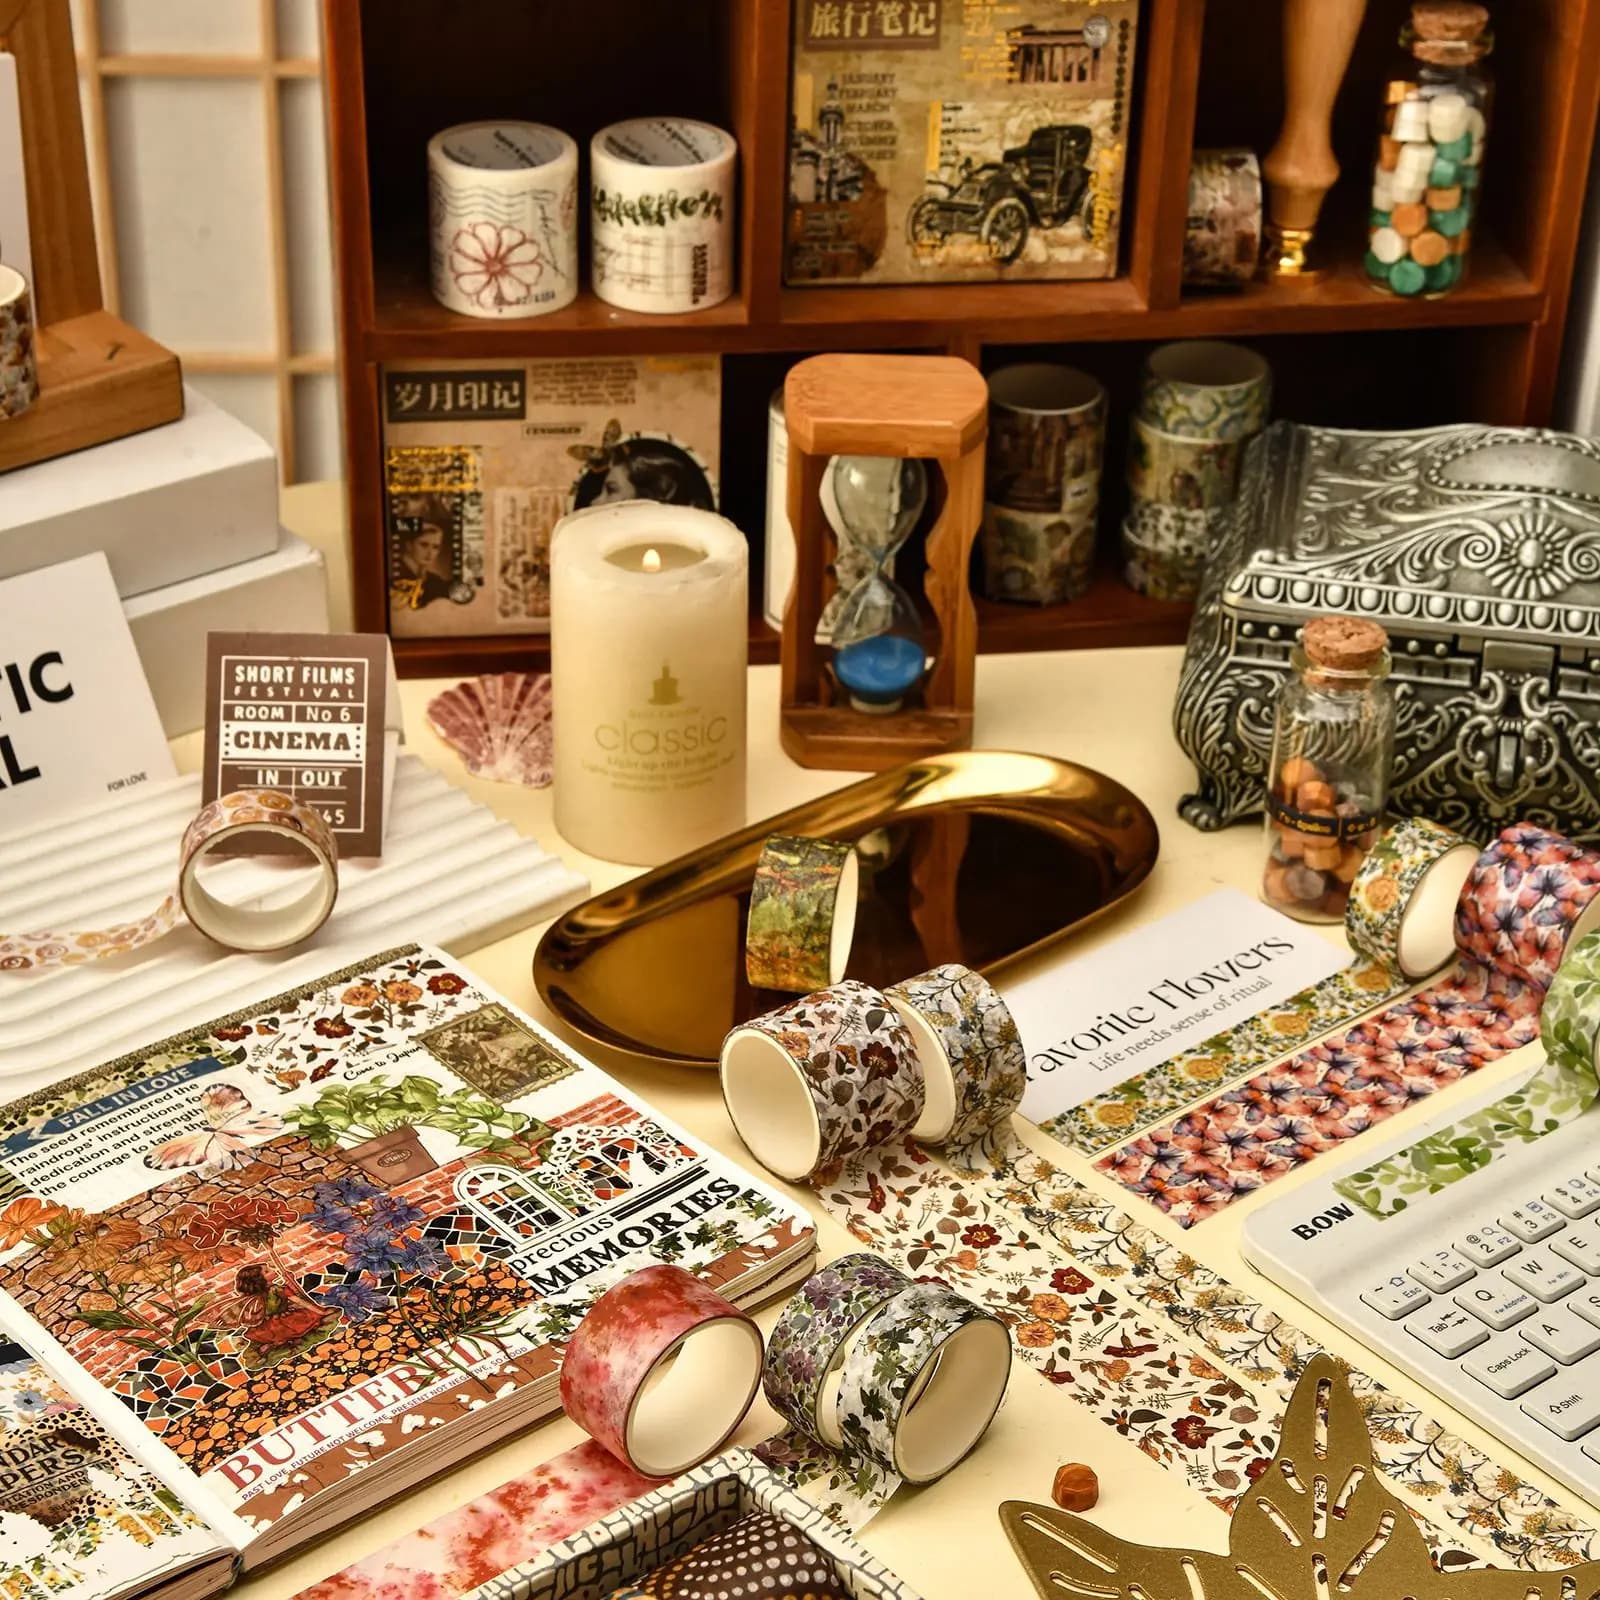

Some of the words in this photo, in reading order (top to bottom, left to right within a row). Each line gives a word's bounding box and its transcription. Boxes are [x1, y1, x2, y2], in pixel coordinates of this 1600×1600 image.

[810, 1, 937, 39] 旅行笔记
[394, 380, 521, 411] 岁月印记
[0, 651, 75, 715] IC
[235, 665, 296, 683] SHORT
[302, 666, 355, 685] FILMS
[234, 686, 355, 699] FESTIVAL
[234, 706, 285, 720] ROOM
[306, 706, 333, 722] No
[340, 707, 351, 722] 6
[233, 730, 351, 751] CINEMA
[594, 716, 728, 756] classic
[107, 778, 126, 792] FOR
[126, 771, 148, 787] LOVE
[257, 770, 279, 785] IN
[301, 771, 342, 786] OUT
[316, 808, 345, 824] 45
[1026, 1005, 1156, 1082] avorite
[1148, 936, 1295, 1010] Flowers
[1088, 1050, 1125, 1073] Life
[1126, 1028, 1172, 1057] needs
[1172, 1007, 1213, 1033] sense
[1213, 994, 1232, 1012] of
[1231, 975, 1273, 1003] ritual
[59, 1103, 113, 1128] FALL
[112, 1089, 139, 1107] IN
[138, 1067, 194, 1095] LOVE
[6, 1151, 38, 1167] The
[41, 1132, 78, 1153] seed
[80, 1092, 174, 1136] remembered
[173, 1083, 200, 1096] the
[19, 1138, 93, 1177] raindrops'
[96, 1102, 185, 1142] instructions
[185, 1094, 204, 1104] fo
[30, 1147, 110, 1187] dedication
[113, 1133, 141, 1151] and
[143, 1107, 205, 1136] strength
[39, 1181, 67, 1196] the
[69, 1152, 131, 1183] courage
[134, 1143, 149, 1155] to
[152, 1130, 184, 1147] take
[184, 1119, 209, 1132] the
[1571, 1196, 1582, 1204] 4
[1512, 1210, 1524, 1219] #
[1524, 1219, 1538, 1229] 3
[508, 1216, 615, 1275] precious
[527, 1176, 741, 1296] MEMORIES
[1466, 1235, 1481, 1244] @
[1480, 1243, 1495, 1253] 2
[1497, 1236, 1512, 1246] F2
[1569, 1237, 1588, 1249] E
[1452, 1262, 1466, 1271] F1
[1521, 1260, 1543, 1275] W
[1402, 1287, 1422, 1299] Esc
[1475, 1289, 1496, 1302] Q
[1428, 1322, 1449, 1335] Tab
[1542, 1324, 1560, 1336] A
[1487, 1358, 1511, 1375] Caps
[1511, 1347, 1532, 1363] Lock
[215, 1327, 514, 1494] BUTTERFL
[1559, 1394, 1584, 1410] Shift
[242, 1483, 265, 1501] PAST
[264, 1468, 291, 1486] LOVE,
[291, 1446, 328, 1470] FUTURE
[327, 1435, 346, 1449] NOT
[346, 1414, 392, 1438] WELCOME,
[391, 1393, 430, 1415] PRESENT
[430, 1384, 448, 1396] NOT
[491, 1357, 503, 1367] SO
[0, 1449, 85, 1494] PERS
[58, 1470, 85, 1484] AND
